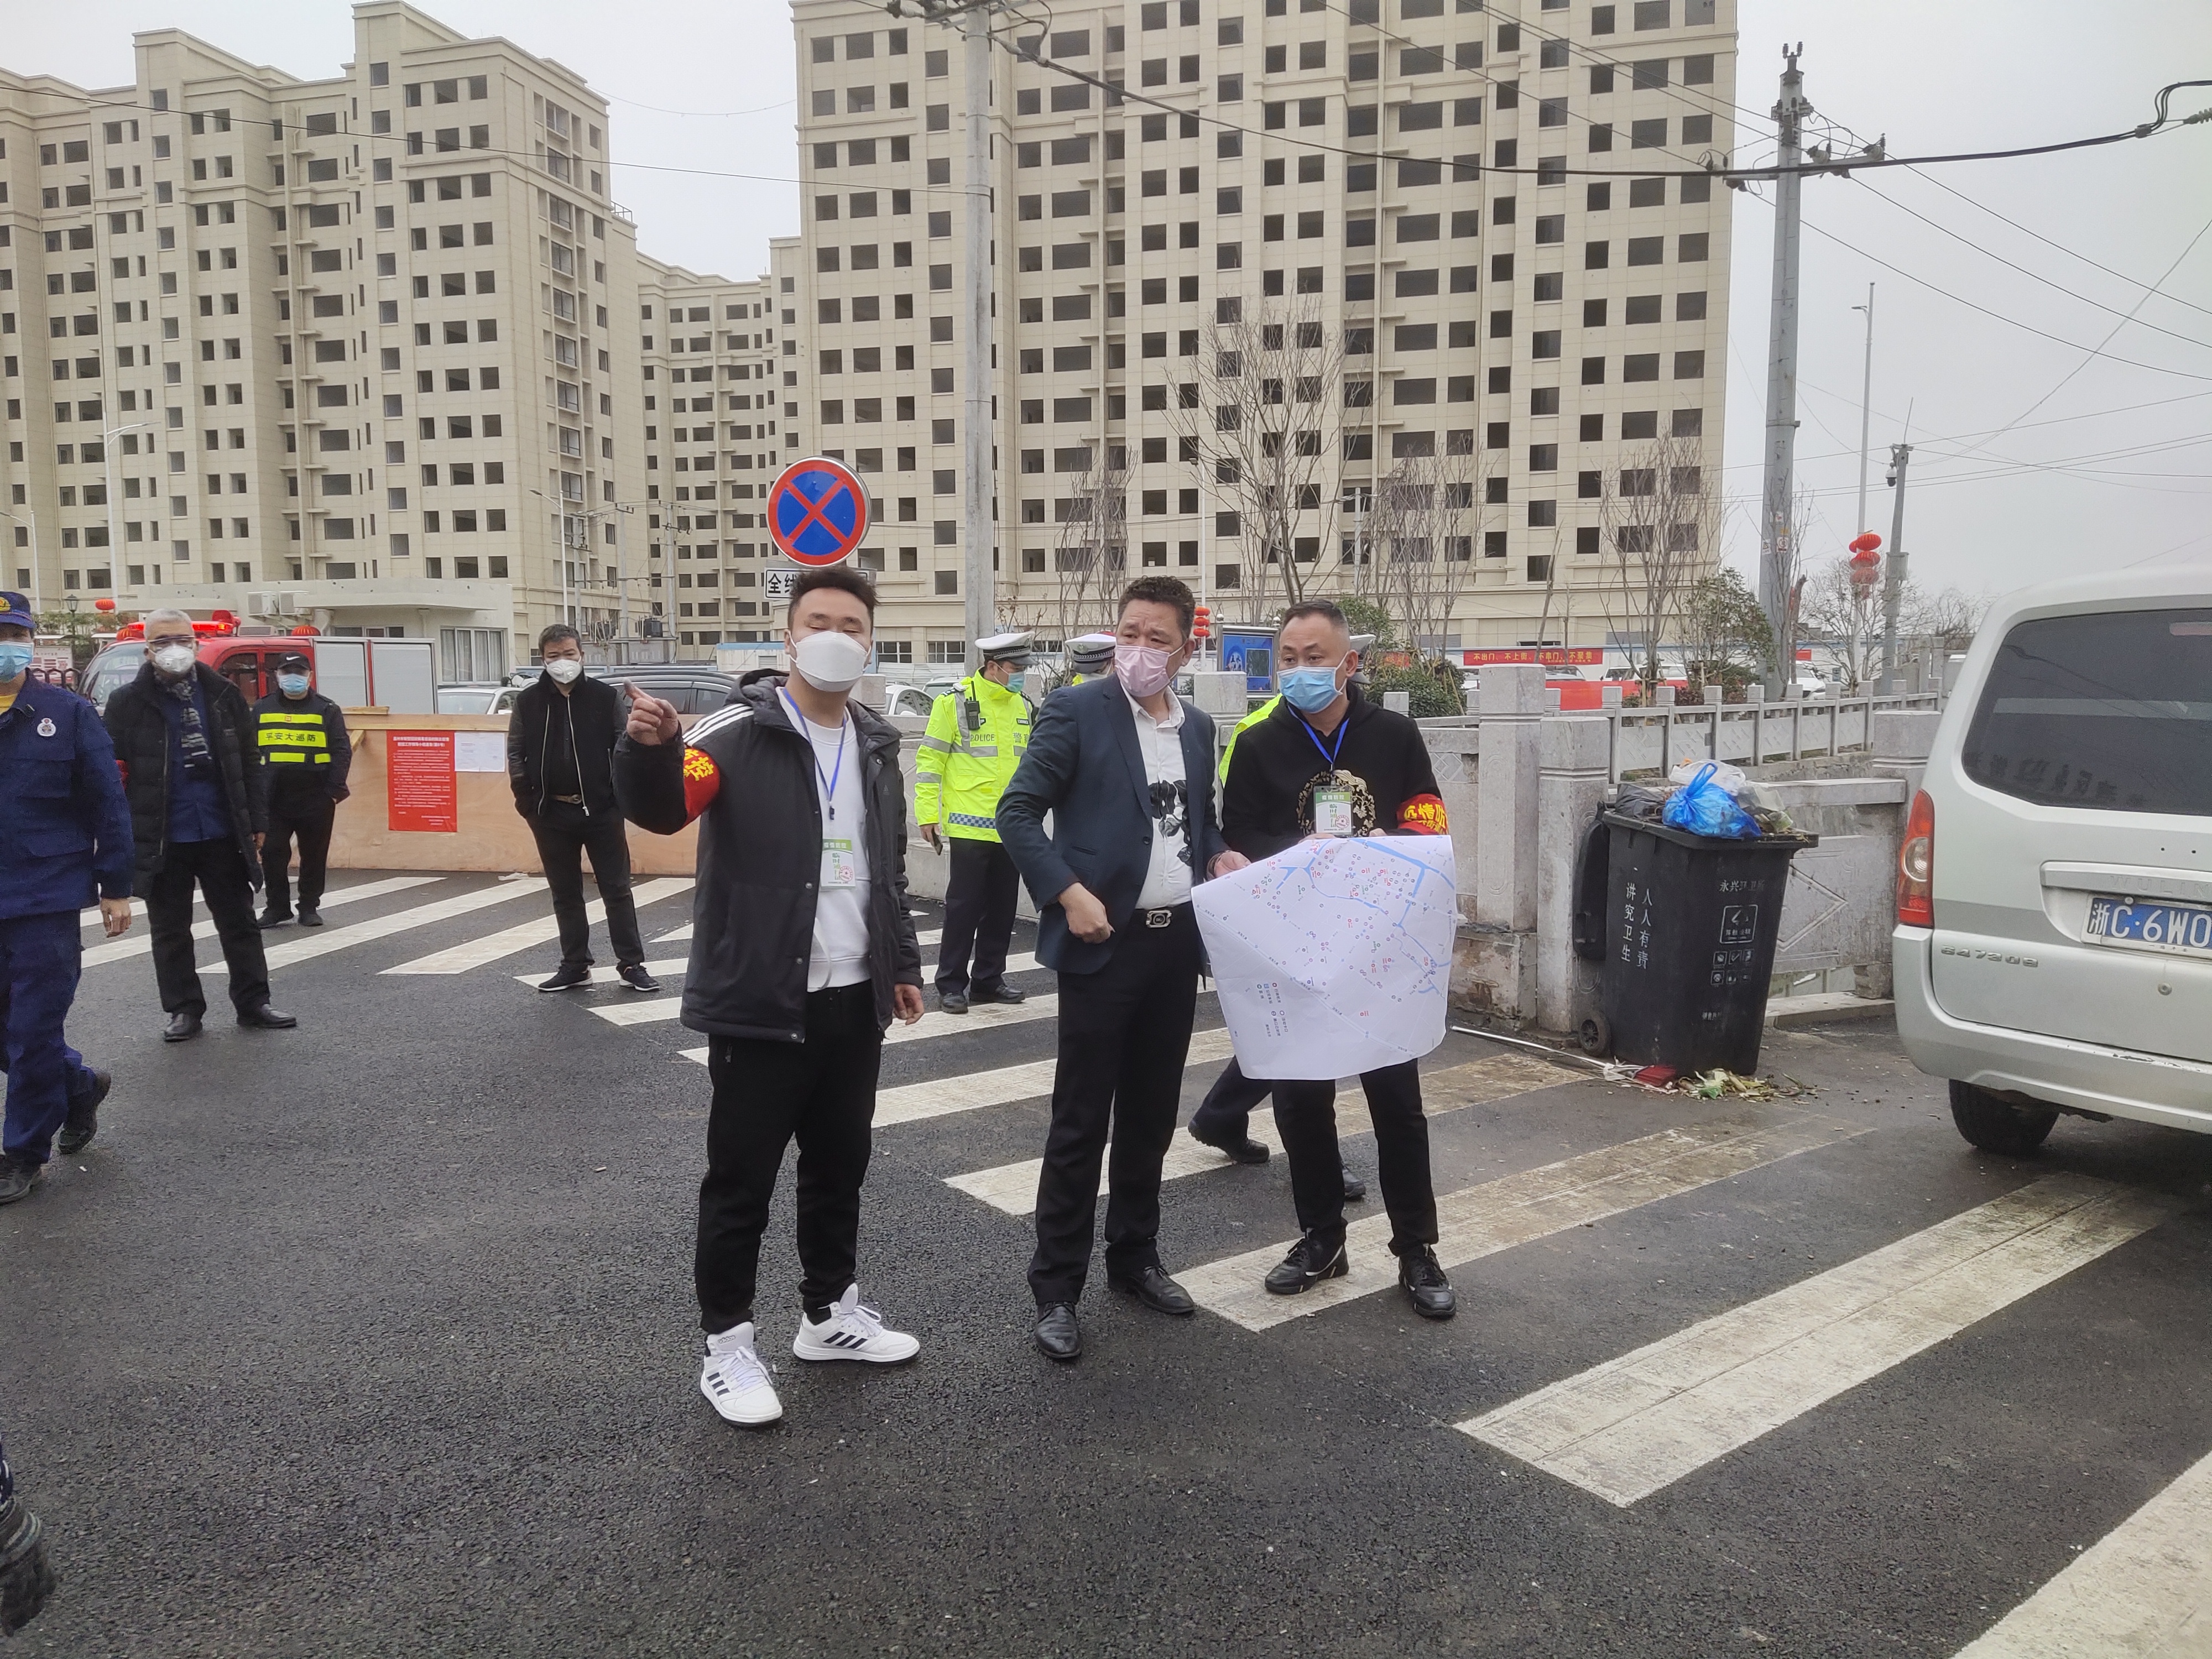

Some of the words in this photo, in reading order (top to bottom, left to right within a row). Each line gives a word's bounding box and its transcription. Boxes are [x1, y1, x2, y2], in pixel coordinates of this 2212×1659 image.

[265, 732, 316, 742] 平安大巡防
[970, 733, 995, 742] POLICE
[1621, 882, 1636, 962] 讲究卫生
[1637, 888, 1652, 969] 人人有责
